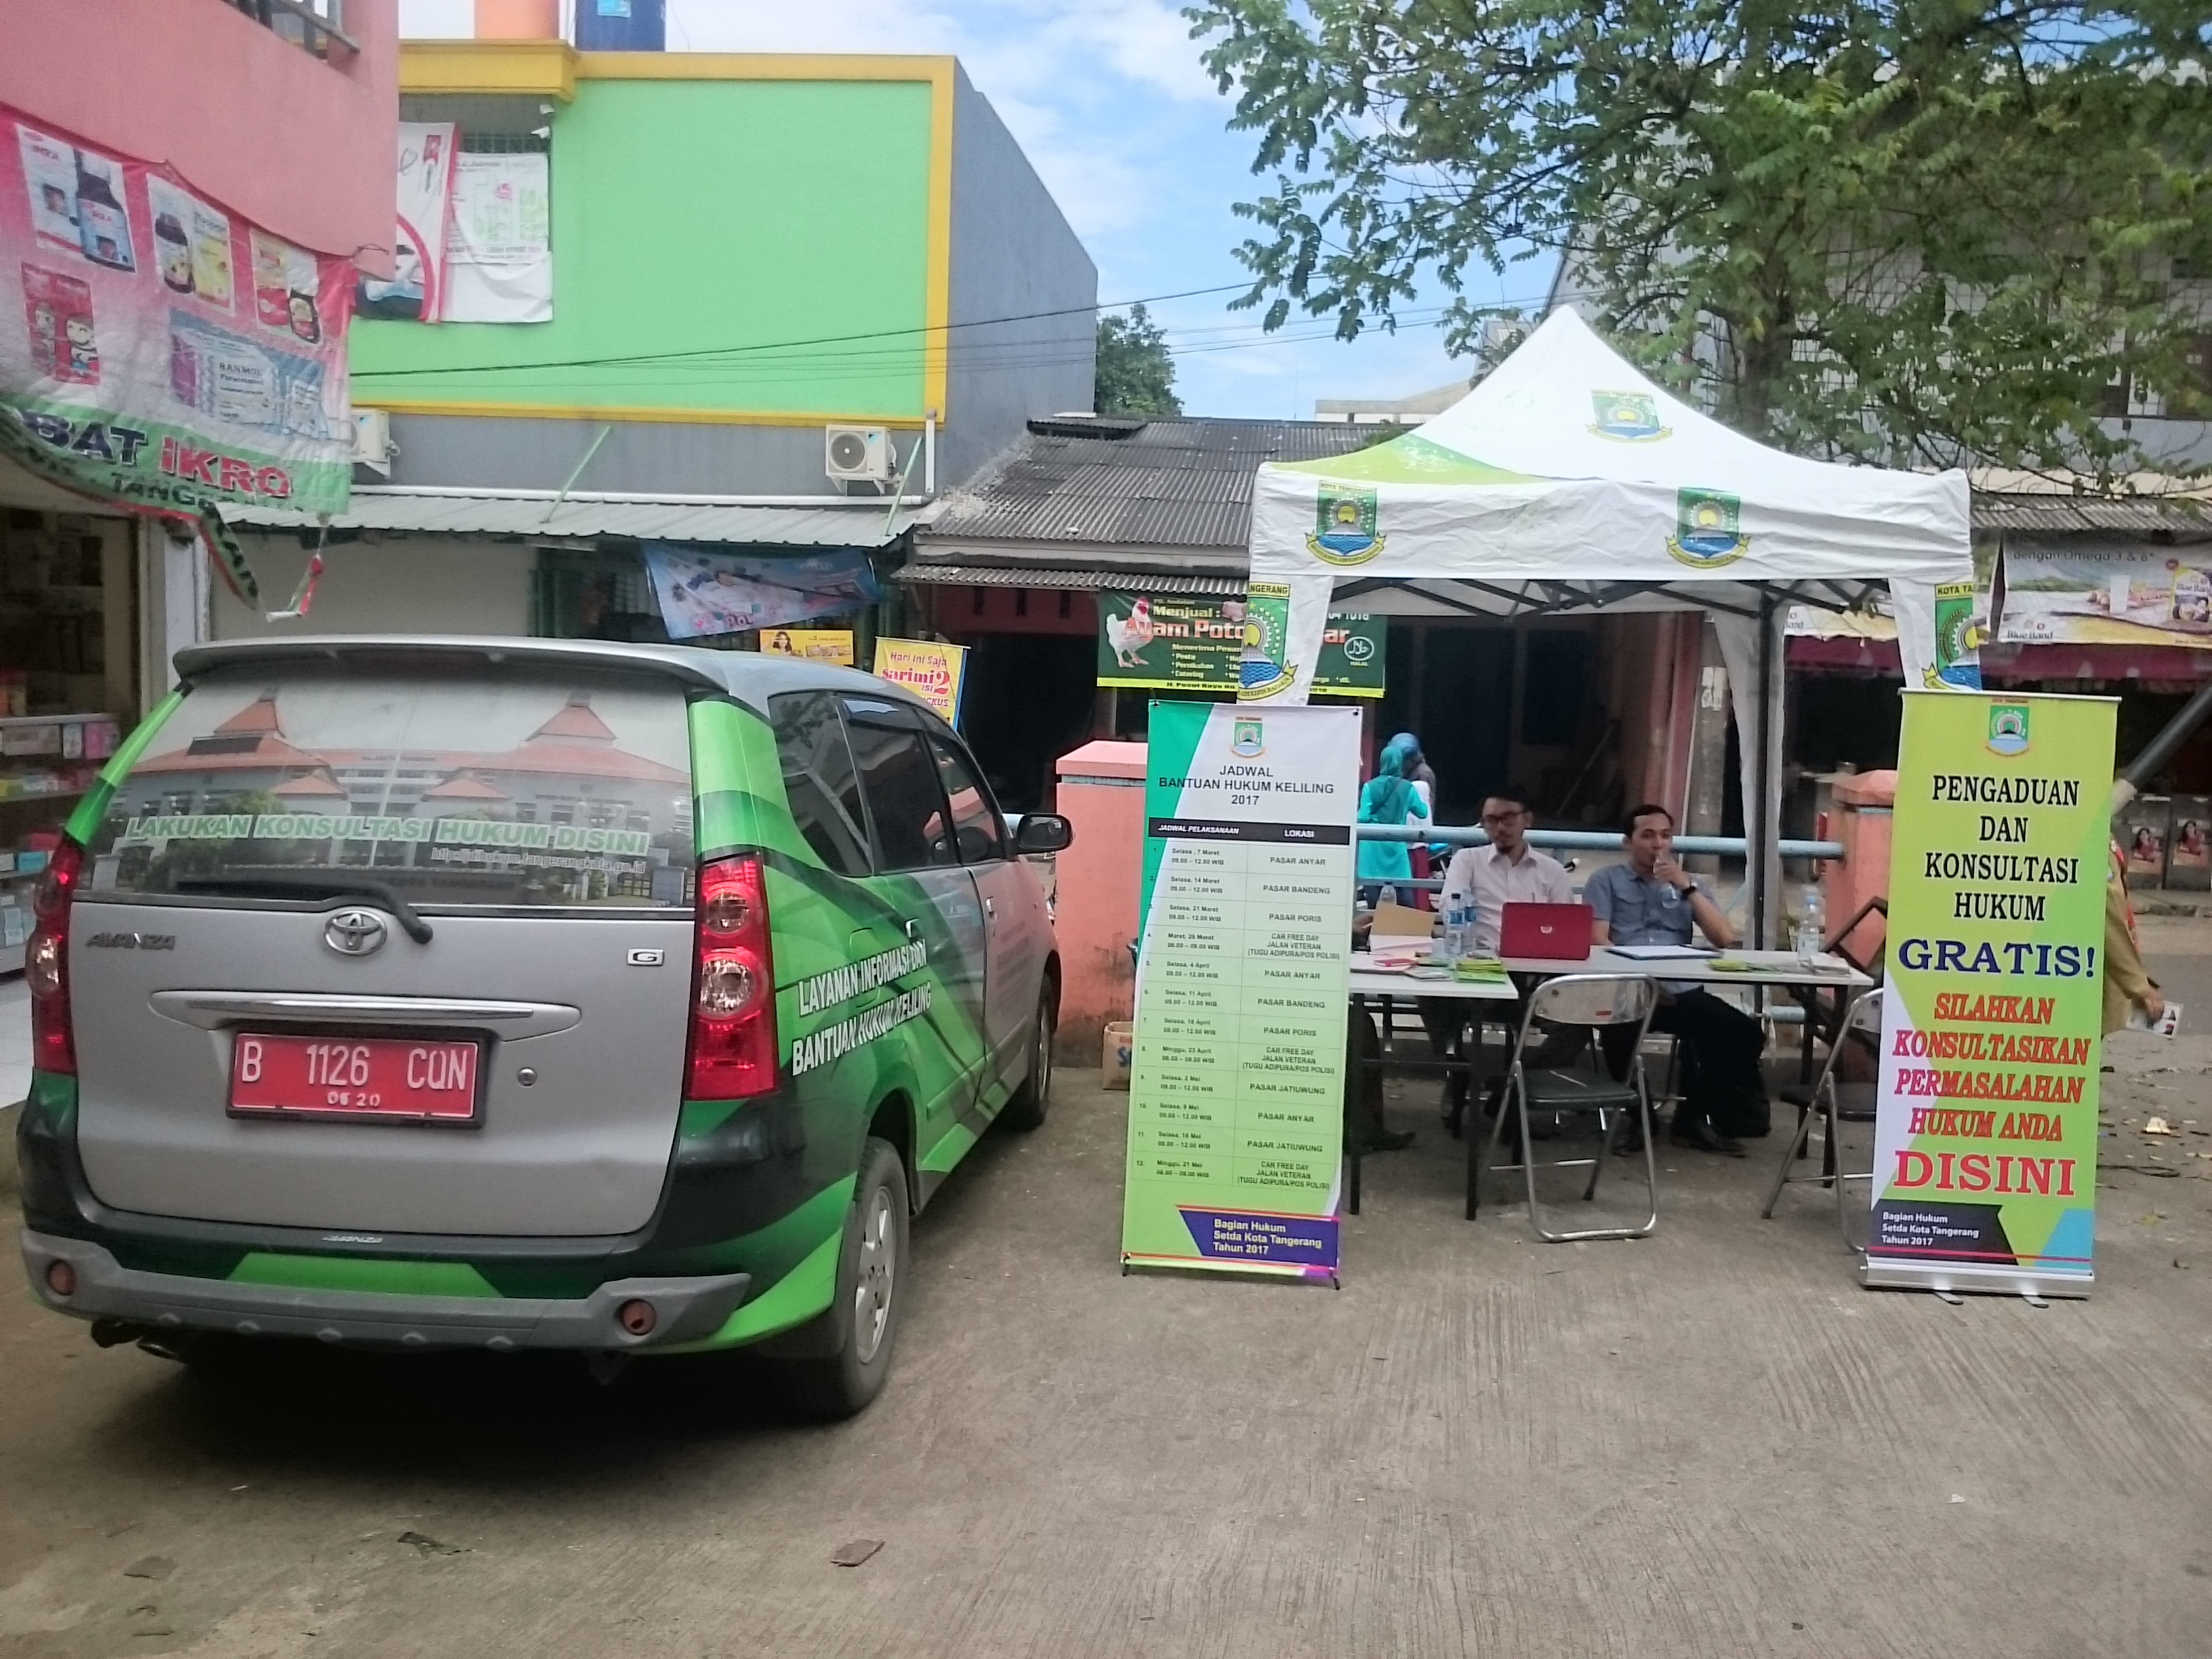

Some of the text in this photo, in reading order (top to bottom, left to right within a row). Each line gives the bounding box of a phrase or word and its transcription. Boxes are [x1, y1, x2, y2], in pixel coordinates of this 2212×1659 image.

[160, 436, 293, 498] IKRO
[2013, 551, 2060, 562] dengan
[2064, 552, 2110, 563] Omega
[2114, 552, 2122, 561] 3
[2127, 552, 2135, 562] &
[1250, 586, 1288, 594] NGERANG
[1938, 586, 1973, 595] KOTA TA
[1153, 606, 1212, 618] Menjual
[1123, 617, 1189, 640] Ayam
[2007, 630, 2053, 640] Blue Band
[1172, 643, 1214, 652] Menerima
[890, 652, 947, 666] Hari Ini Saja
[882, 668, 950, 695] sarimi 2
[1220, 765, 1273, 777] JADWAL
[1159, 777, 1334, 794] BANTUAN HUKUM KELILING
[1932, 775, 2079, 806] PENGADUAN
[1231, 795, 1259, 805] 2017
[127, 815, 649, 855] LAKUKAN KONSULTASI HUKUM DISINI
[1158, 824, 1315, 838] JADWAL PELAKSANAAN LOKASI
[1980, 816, 2028, 842] DAN
[1925, 853, 2078, 884] KONSULTASI
[1954, 893, 2045, 921] HUKUM
[633, 951, 657, 962] G
[1898, 939, 2095, 977] GRATIS!
[798, 938, 927, 1017] LAYANAN INFORMASI DAN
[1265, 970, 1320, 979] PASAR ANYAR
[1286, 1000, 1325, 1008] BANDENG
[1934, 993, 2055, 1025] SILAHKAN
[792, 981, 931, 1076] BANTUAN HUKUM KELILING
[1892, 1029, 2091, 1065] KONSULTASIKAN
[242, 1041, 468, 1091] B 1126 CQN
[1279, 1085, 1326, 1094] JATIUWUNG
[1894, 1069, 2086, 1104] PERMASALAHAN
[356, 1093, 380, 1107] 20
[1258, 1113, 1314, 1122] PASAR ANYAR
[1908, 1107, 2062, 1142] HUKUM ANDA
[1247, 1141, 1323, 1152] PASAR JATIUWUNG
[1280, 1170, 1311, 1179] VETERAN
[1893, 1150, 2076, 1196] DISINI
[1883, 1211, 1948, 1223] Bagian Hukum
[1214, 1218, 1286, 1232] Bagian Hukum
[1882, 1223, 1980, 1238] Setda Kota Tangerang
[1213, 1230, 1322, 1248] Setda Kota Tangerang
[1881, 1235, 1933, 1246] Tahun 2017
[1213, 1242, 1269, 1254] Tahun 2017
